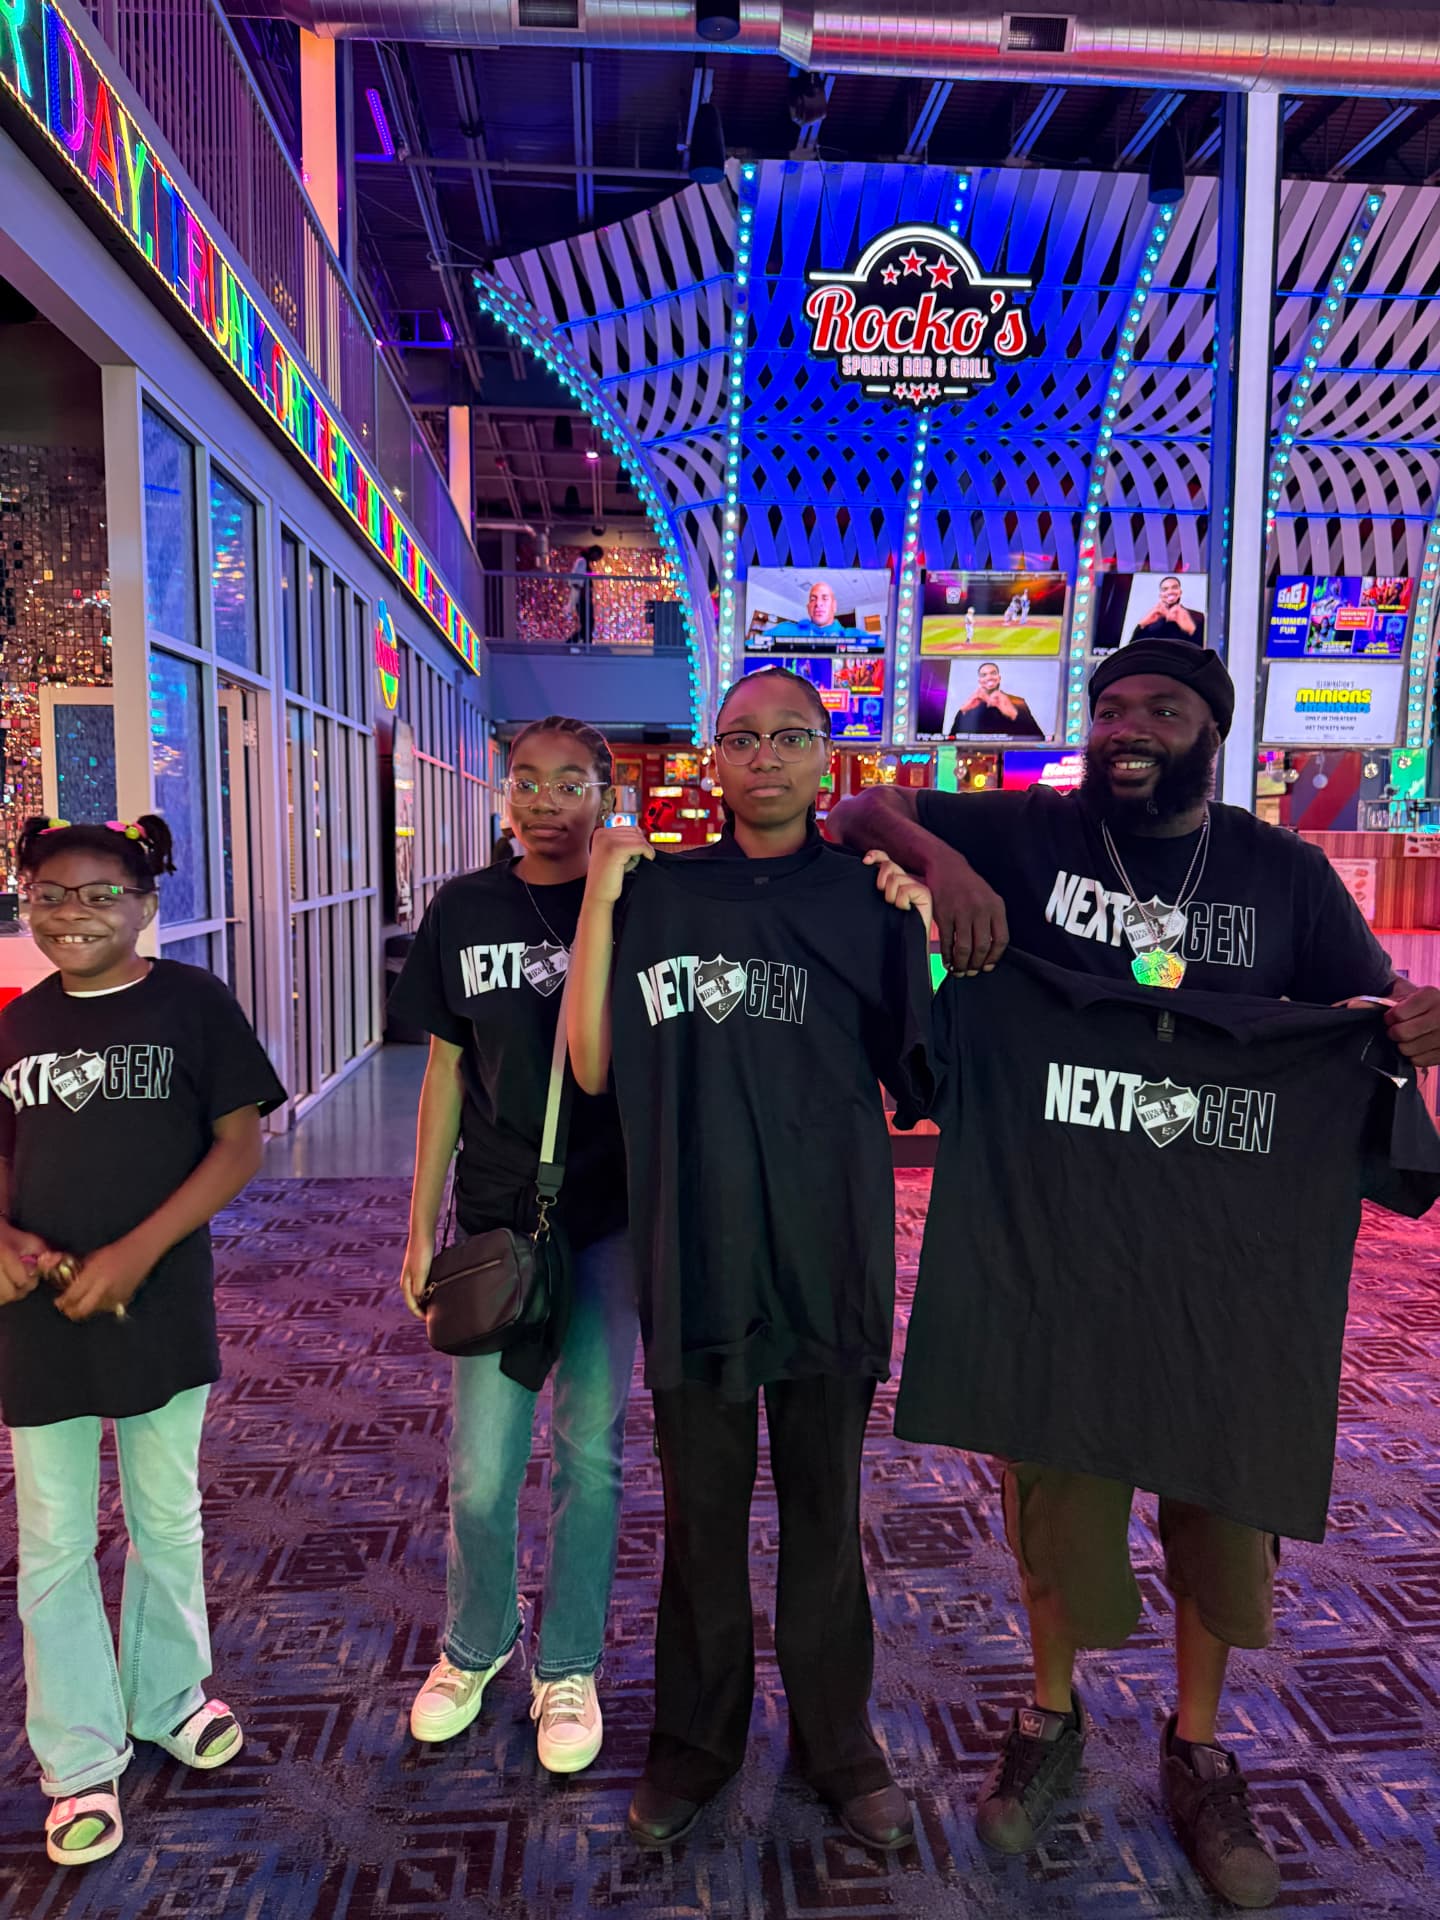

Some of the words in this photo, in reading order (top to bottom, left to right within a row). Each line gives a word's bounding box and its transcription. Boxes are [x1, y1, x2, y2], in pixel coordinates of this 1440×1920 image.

[161, 172, 268, 402] TRUNK
[271, 343, 304, 449] OR
[806, 284, 1028, 356] Rocko's
[842, 354, 899, 377] SPORTS
[902, 356, 932, 378] BAR
[936, 358, 948, 378] &
[950, 357, 991, 379] GRILL
[1045, 870, 1131, 947] NEXT
[1182, 902, 1256, 968] GEN
[460, 942, 526, 998] NEXT
[637, 956, 699, 1026] NEXT
[745, 959, 808, 1024] GEN
[102, 1045, 174, 1100] GEN
[1045, 1062, 1142, 1132] NEXT
[1193, 1084, 1276, 1153] GEN
